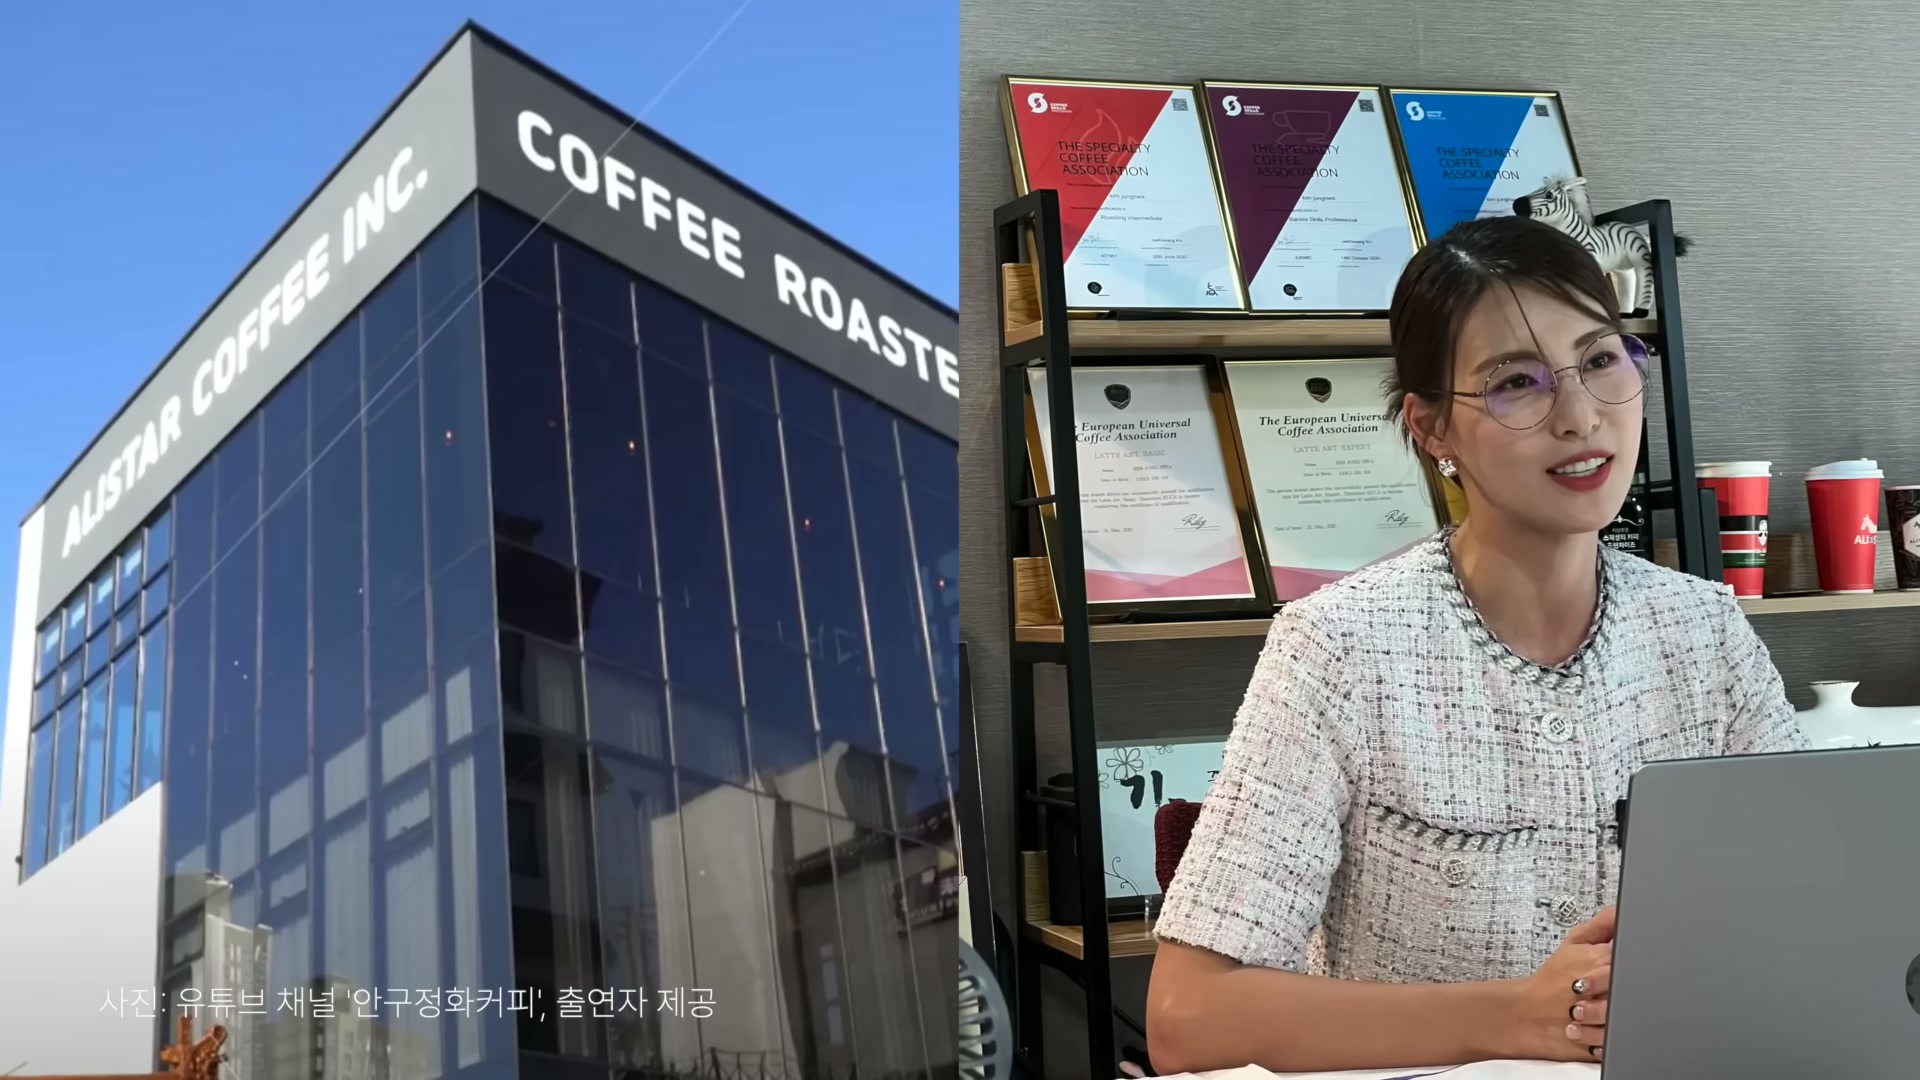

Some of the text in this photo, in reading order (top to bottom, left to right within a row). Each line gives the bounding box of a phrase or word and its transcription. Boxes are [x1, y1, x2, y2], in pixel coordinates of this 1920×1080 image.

[1057, 141, 1151, 153] THE SPECIALTY
[1252, 143, 1340, 155] THE SPECIALTY
[1436, 147, 1519, 158] THE SPECIALTY
[1059, 153, 1109, 163] COFFEE
[1253, 155, 1300, 166] COFFEE
[1438, 158, 1482, 168] COFFEE
[1062, 165, 1149, 176] ASSOCIATION
[1257, 167, 1339, 178] ASSOCIATION
[1442, 170, 1520, 180] ASSOCIATION
[518, 110, 959, 399] COFFEE ROASTE
[62, 146, 428, 559] ALISTAR COFFEE INC.
[1258, 412, 1388, 426] The European Universa
[1082, 422, 1135, 433] European
[1139, 418, 1191, 430] Universal
[1277, 424, 1379, 438] Coffee Association
[1076, 431, 1177, 445] Coffee Association
[1293, 445, 1320, 453] LATTE
[1322, 444, 1337, 452] ART
